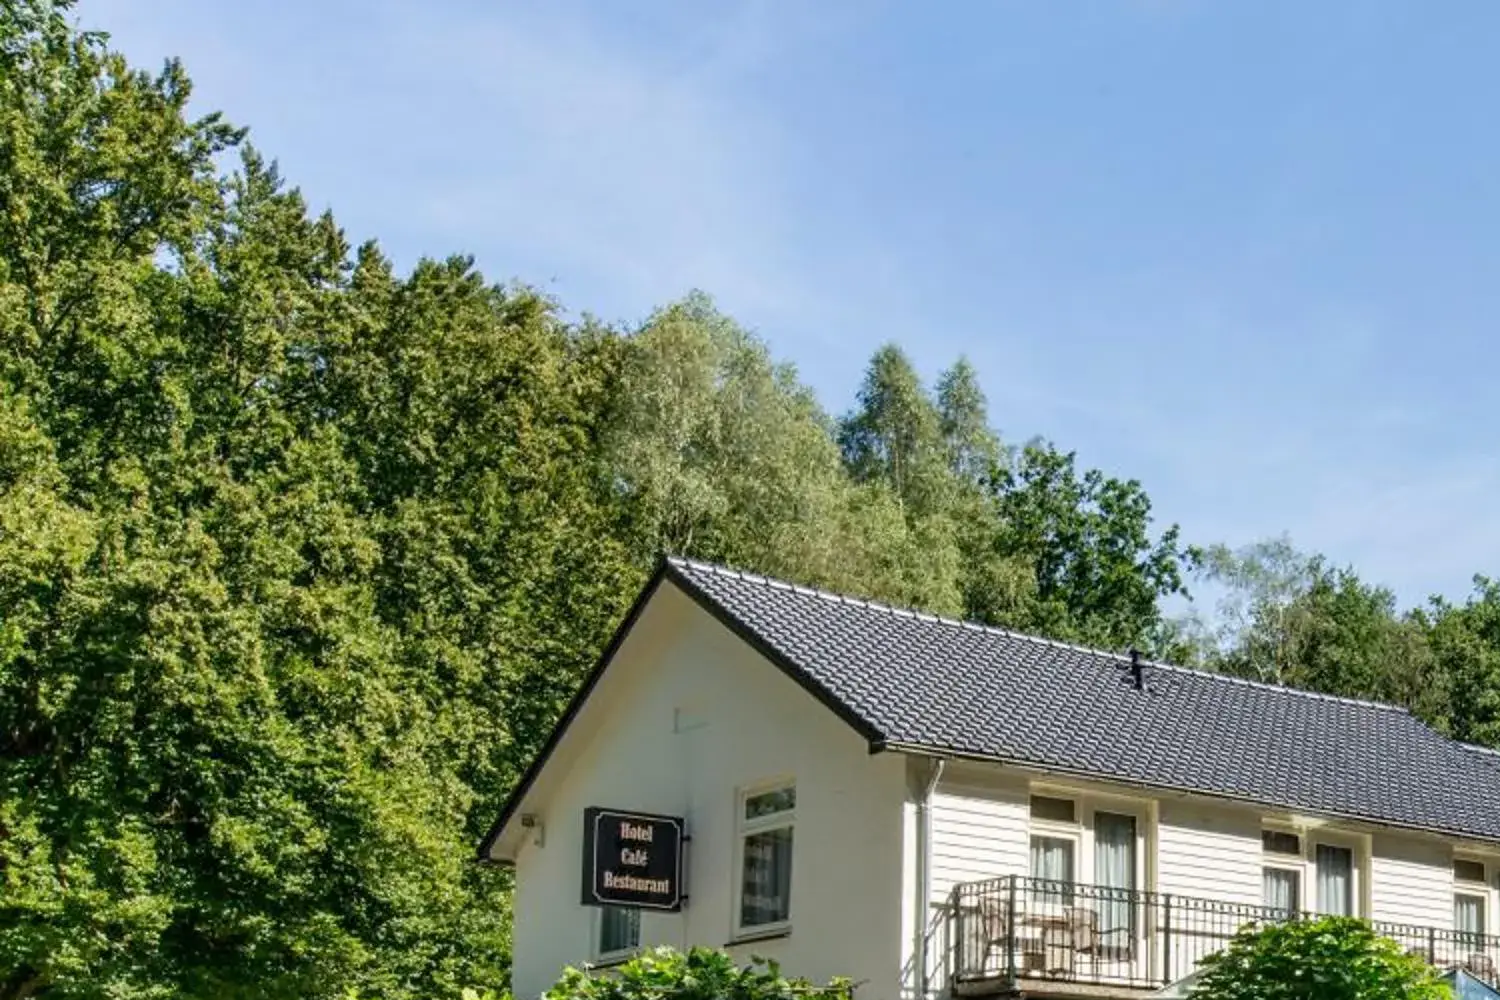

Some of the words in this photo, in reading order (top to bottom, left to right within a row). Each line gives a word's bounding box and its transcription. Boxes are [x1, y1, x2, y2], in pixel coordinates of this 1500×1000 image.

[620, 821, 653, 843] Hotel
[621, 847, 649, 867] Café
[604, 871, 669, 894] Restaurant
